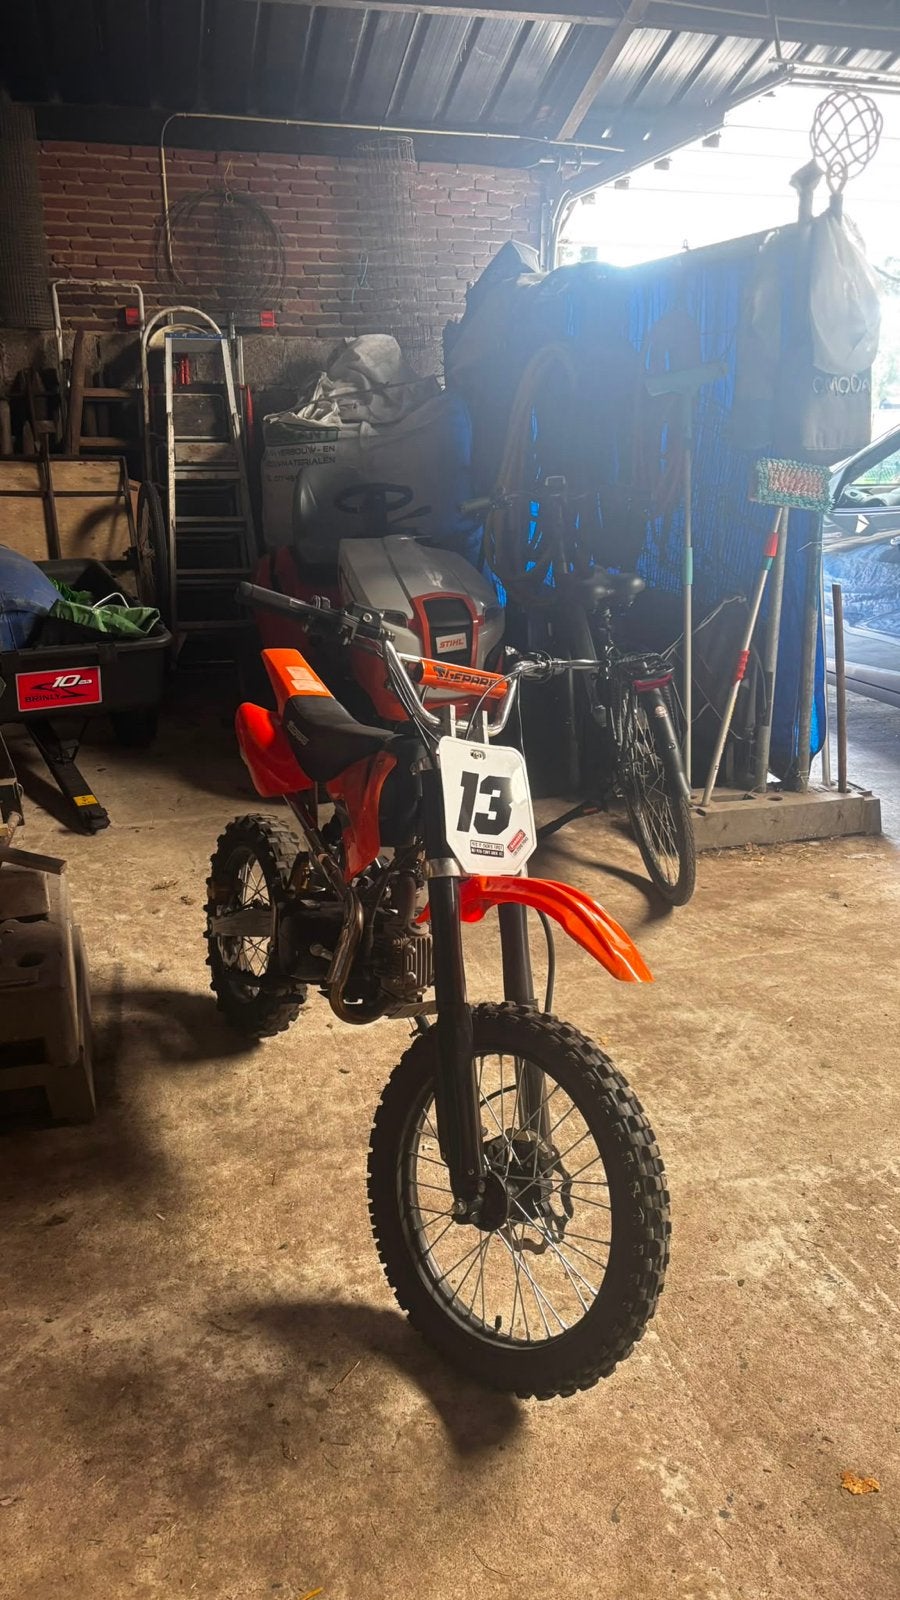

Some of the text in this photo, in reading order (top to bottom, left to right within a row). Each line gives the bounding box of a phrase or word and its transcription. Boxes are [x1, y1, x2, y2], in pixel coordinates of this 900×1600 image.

[440, 638, 465, 649] STIHL
[52, 674, 81, 688] 10
[25, 693, 60, 703] BRINLY
[457, 770, 514, 836] 13
